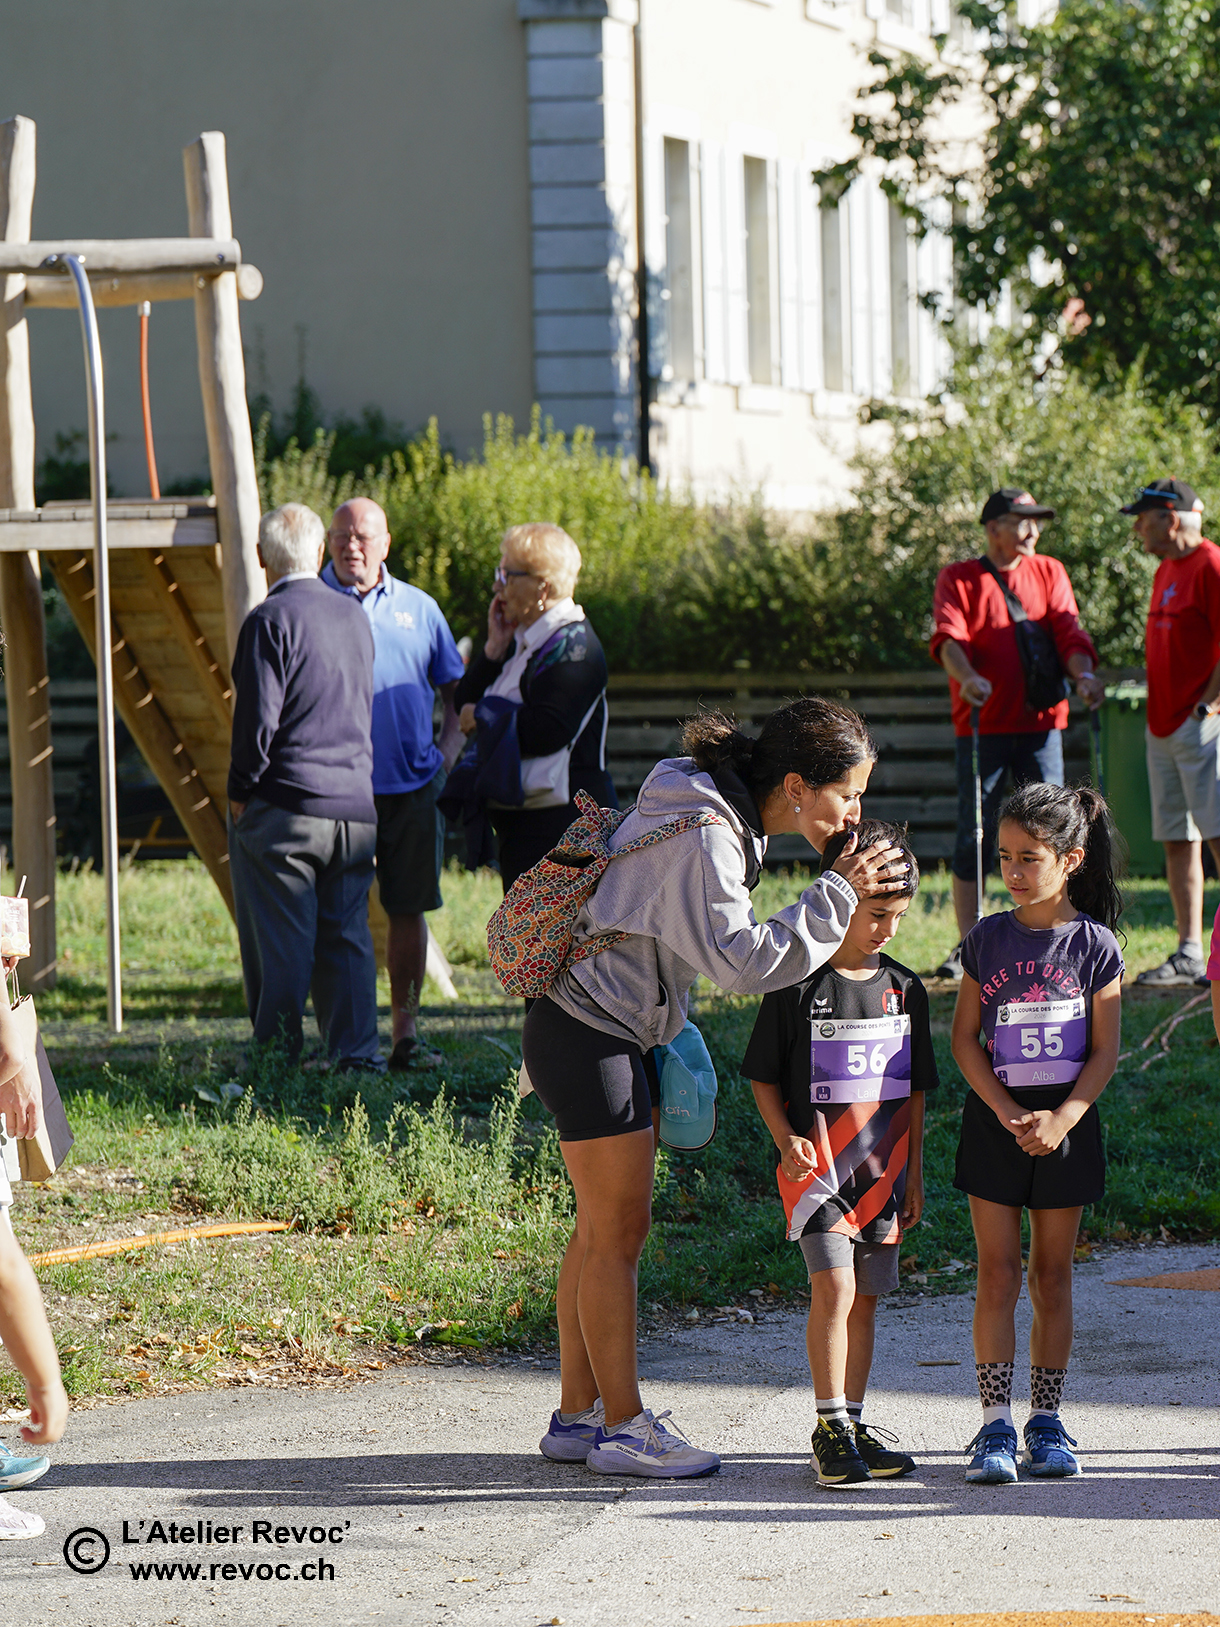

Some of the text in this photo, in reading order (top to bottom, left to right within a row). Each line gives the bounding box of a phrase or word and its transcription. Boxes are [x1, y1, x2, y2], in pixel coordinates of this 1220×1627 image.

[980, 960, 1081, 1005] FREE TO DREA
[1020, 1026, 1064, 1059] 55
[847, 1043, 887, 1075] 56
[1032, 1071, 1055, 1082] Alba
[615, 1445, 639, 1458] SALOMON
